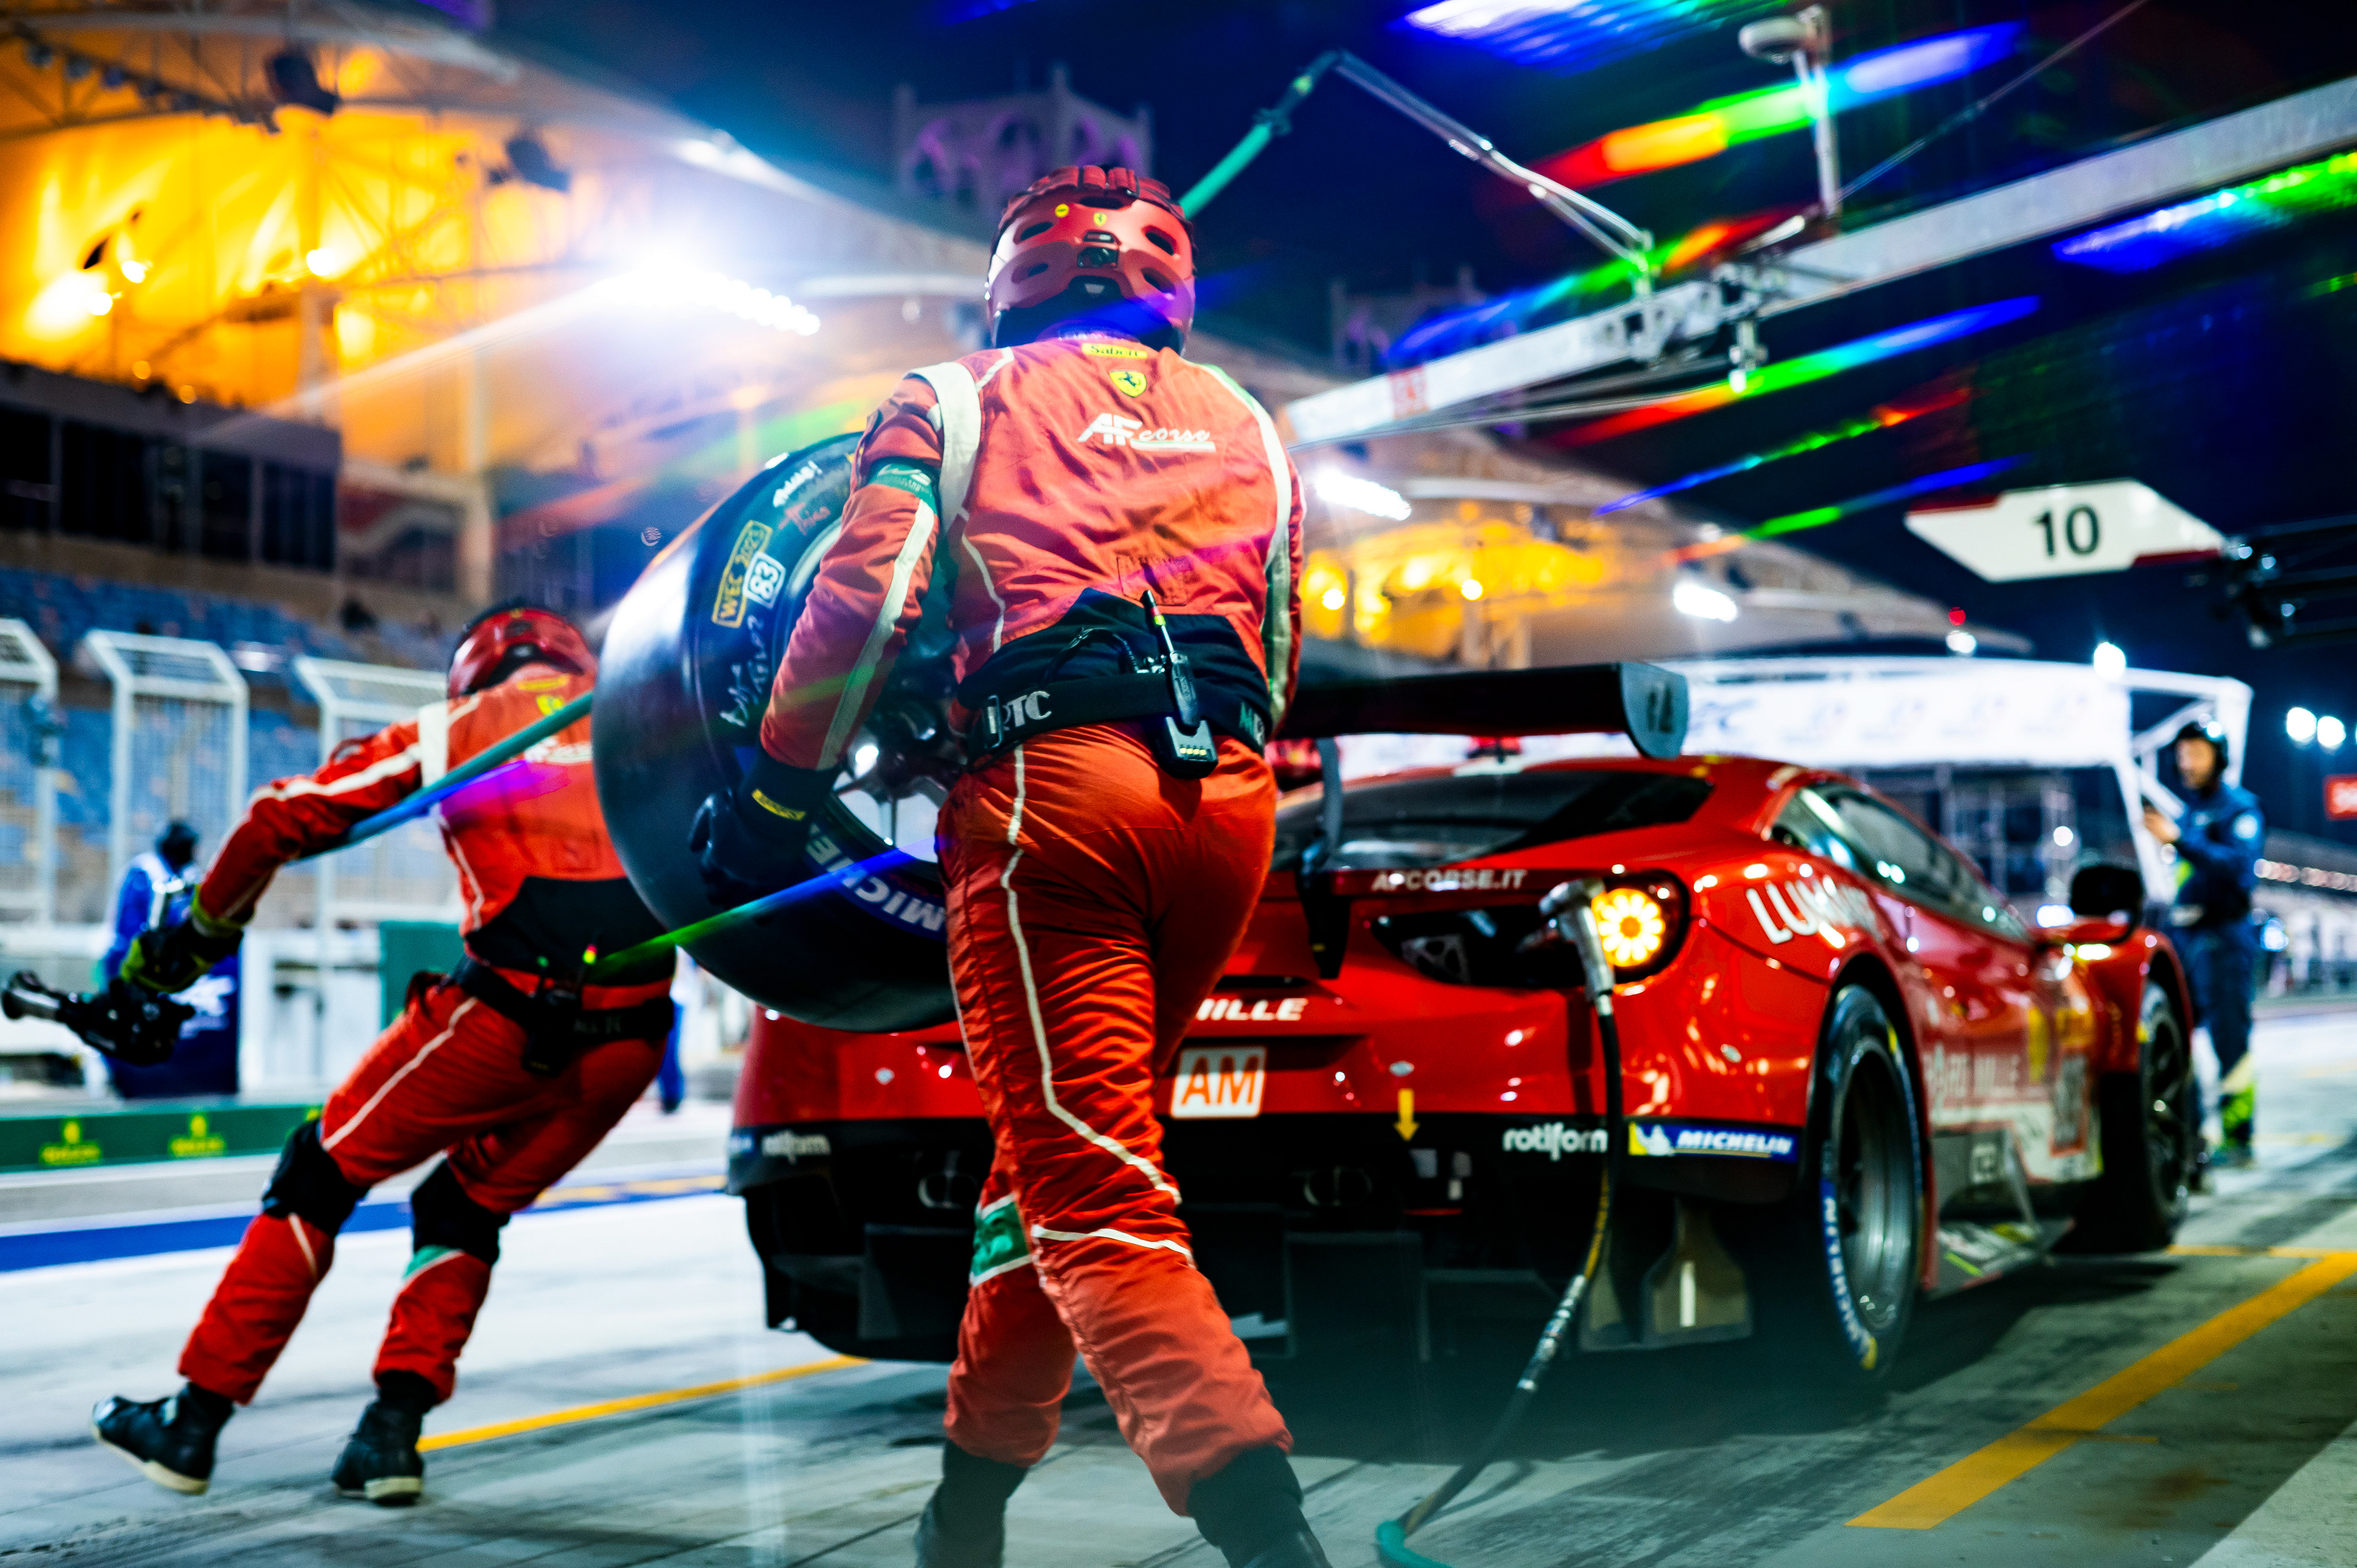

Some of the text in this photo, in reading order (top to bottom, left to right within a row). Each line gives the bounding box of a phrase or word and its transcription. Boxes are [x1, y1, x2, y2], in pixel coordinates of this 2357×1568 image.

[1077, 412, 1143, 446] AF
[2035, 504, 2100, 558] 10
[750, 561, 780, 599] 83
[1182, 1054, 1261, 1104] AM
[1677, 1129, 1793, 1155] MICHELIN
